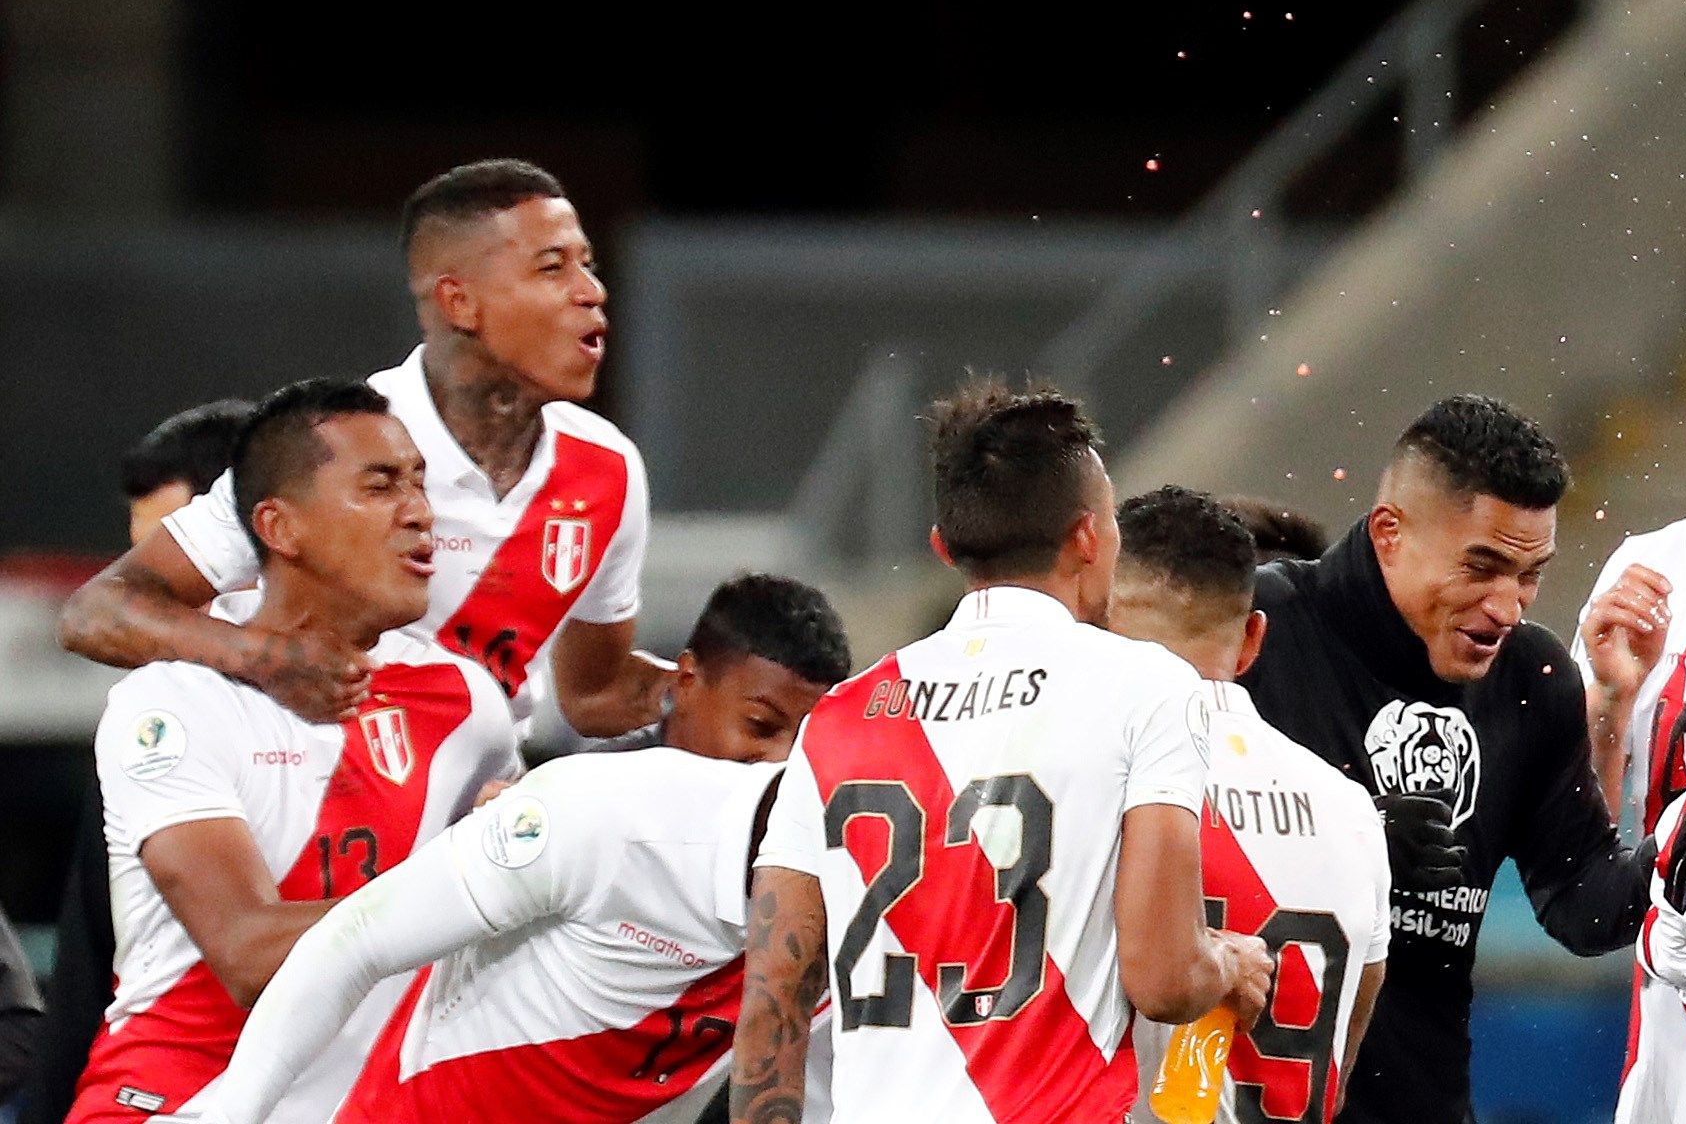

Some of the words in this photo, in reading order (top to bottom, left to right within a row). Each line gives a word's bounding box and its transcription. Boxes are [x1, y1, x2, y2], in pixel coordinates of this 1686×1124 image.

[863, 668, 1047, 722] GONZÁLES
[1203, 779, 1316, 837] YOTÚN
[317, 827, 379, 900] 13
[824, 771, 1055, 1032] 23
[617, 922, 707, 968] marathon
